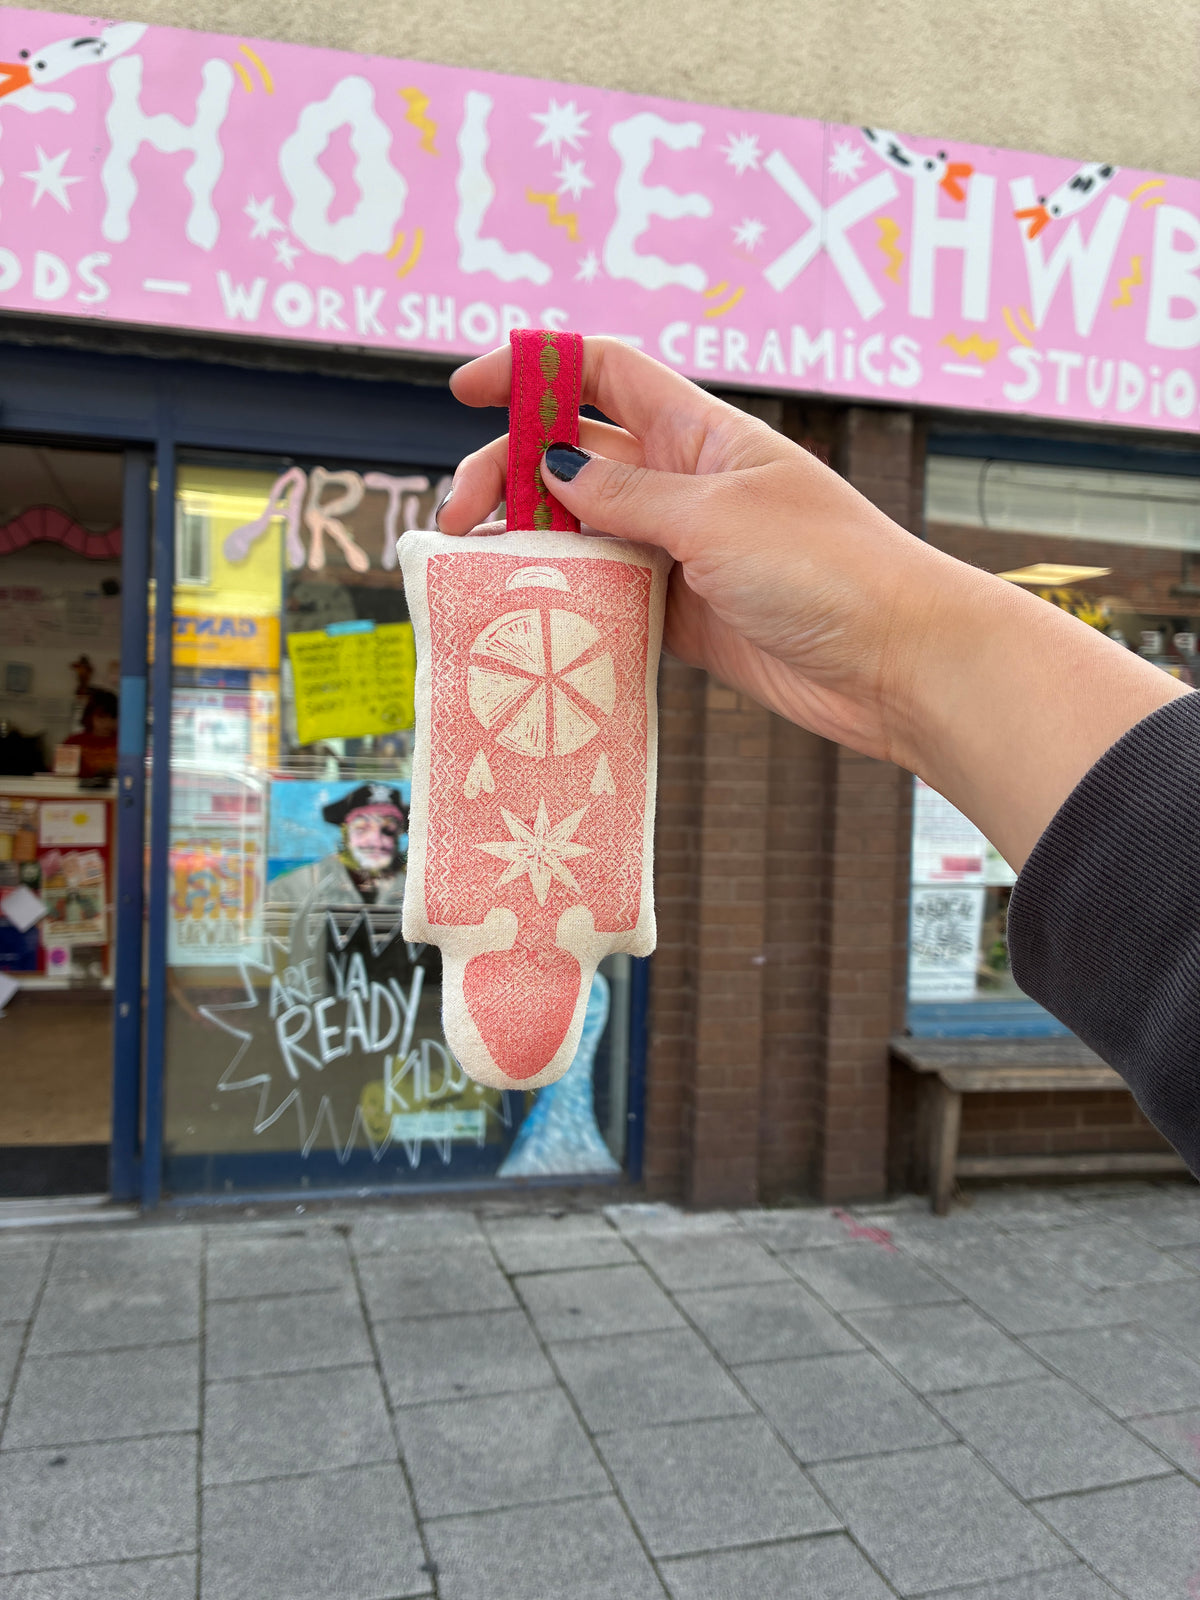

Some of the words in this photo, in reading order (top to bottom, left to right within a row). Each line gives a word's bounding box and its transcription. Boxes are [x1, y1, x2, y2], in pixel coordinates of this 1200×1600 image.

[658, 321, 922, 387] CERAMiCS
[269, 957, 322, 1019] ARE
[328, 952, 370, 1001] YA
[276, 965, 425, 1080] READY
